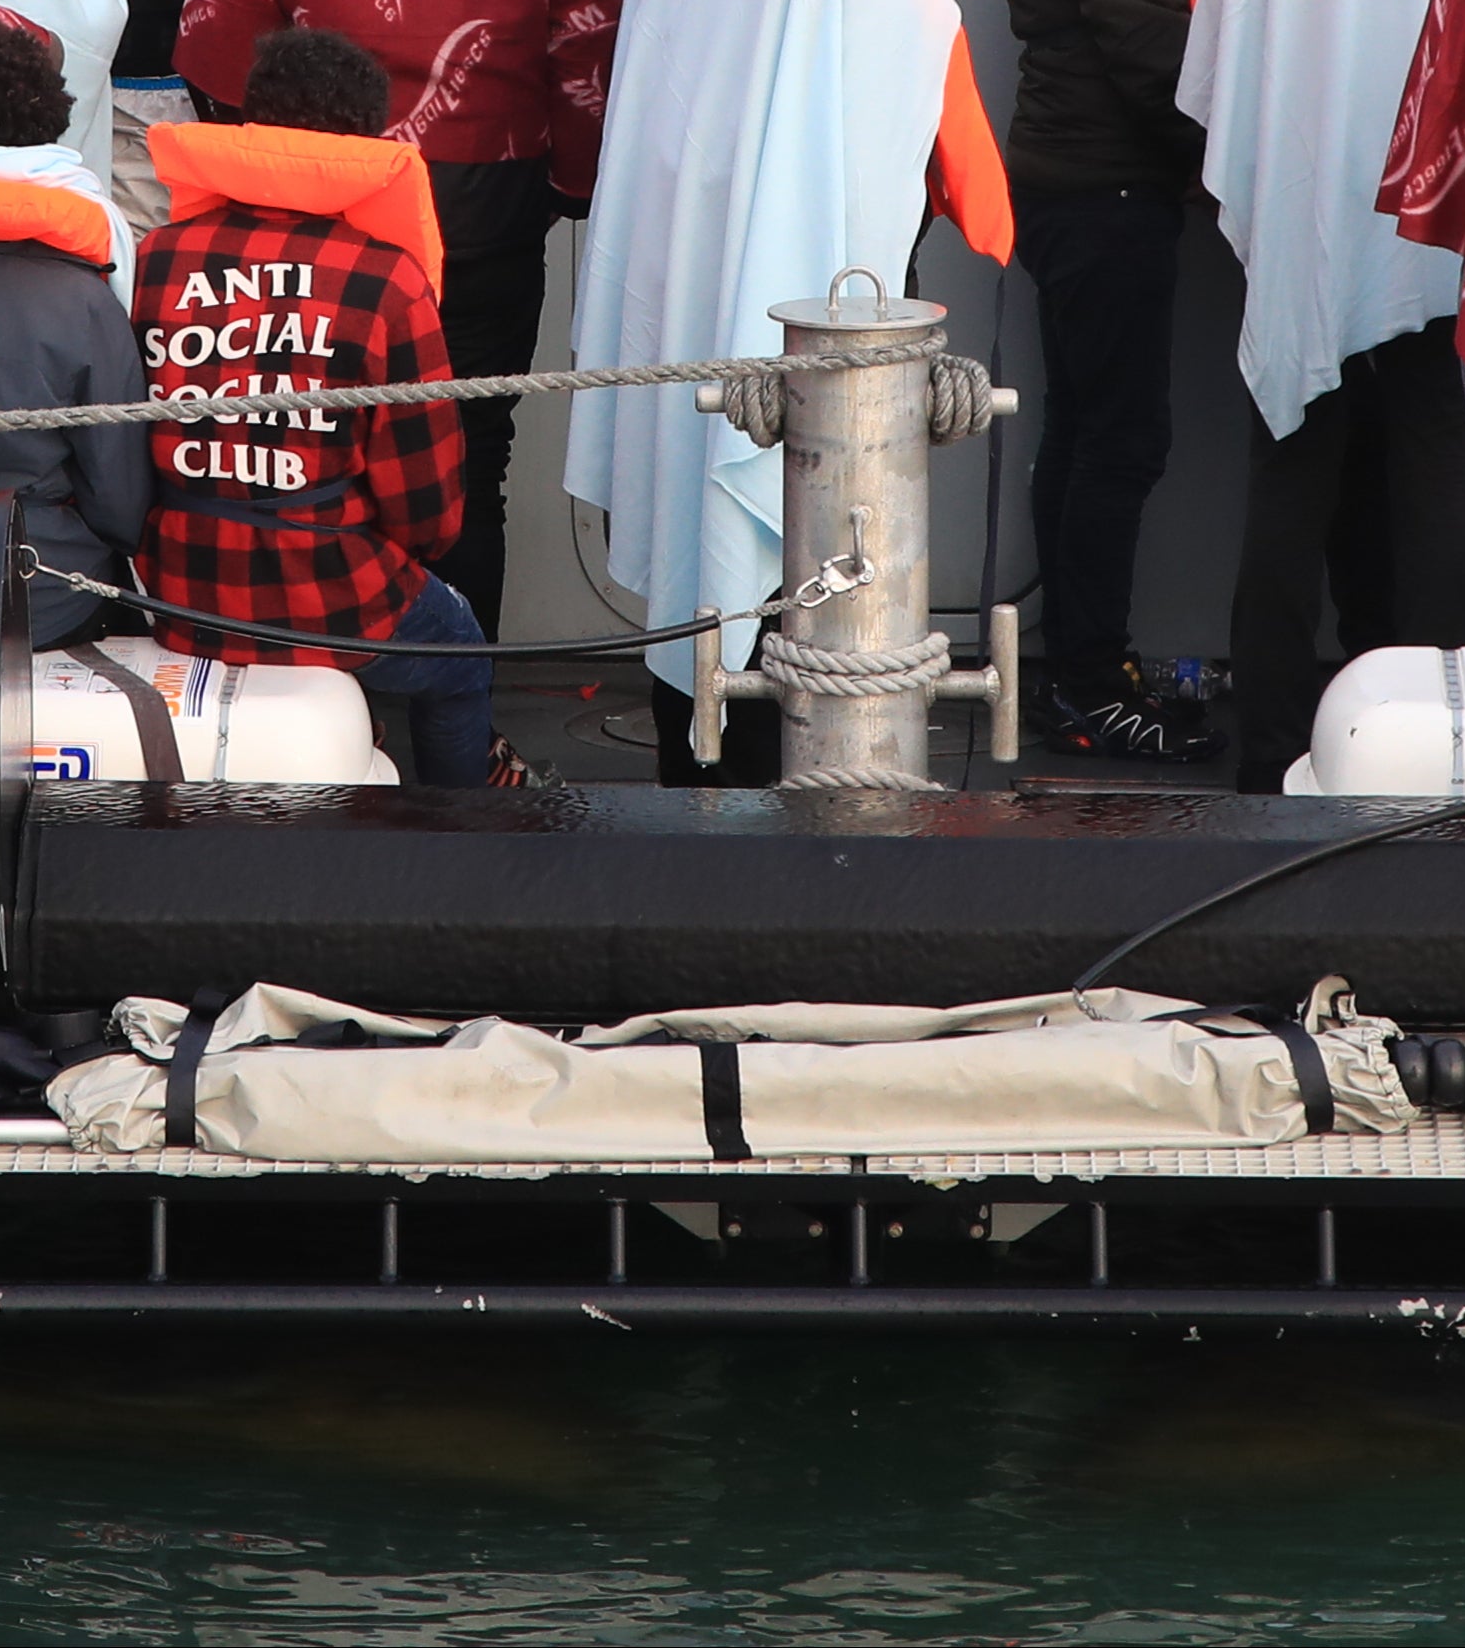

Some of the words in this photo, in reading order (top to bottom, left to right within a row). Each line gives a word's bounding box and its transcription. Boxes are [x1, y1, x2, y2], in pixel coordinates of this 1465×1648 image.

[175, 262, 314, 311] ANTI
[145, 312, 336, 369] SOCIAL
[172, 439, 307, 491] CLUB
[29, 746, 90, 780] FD
